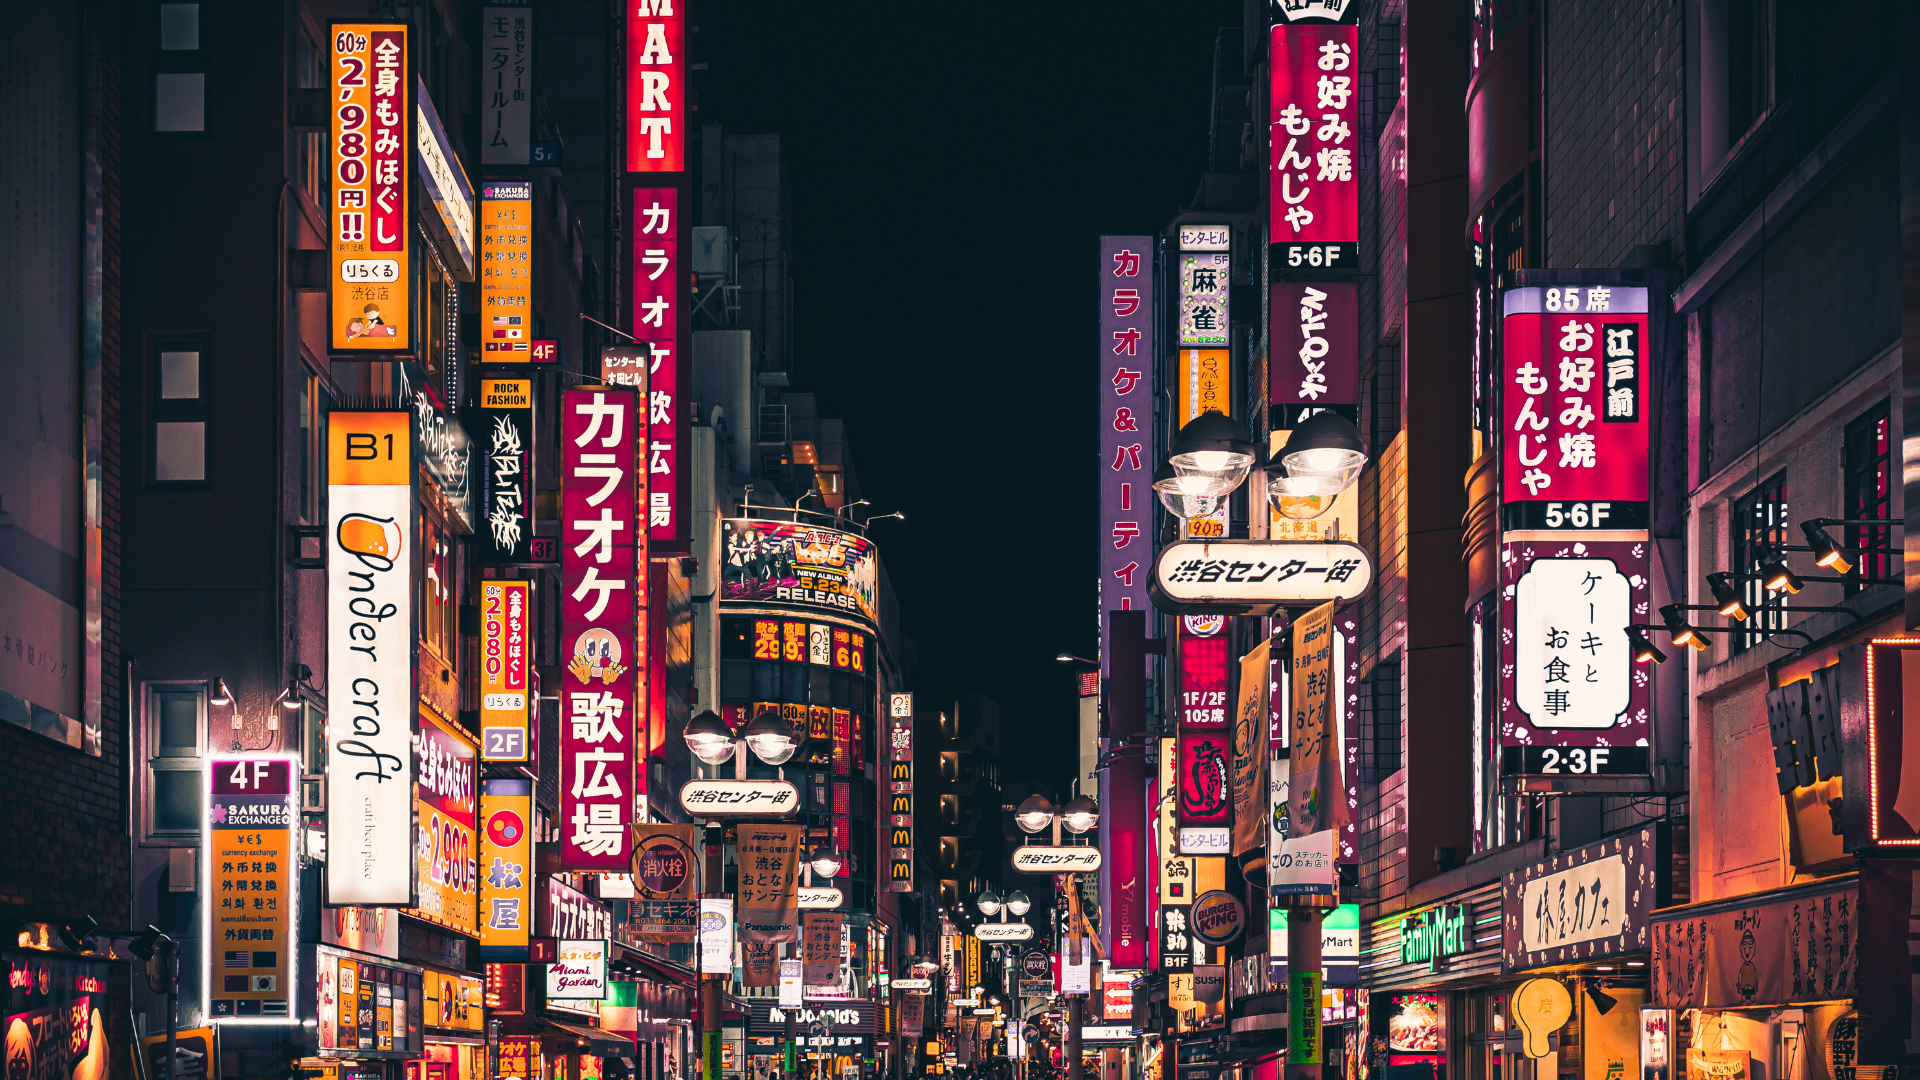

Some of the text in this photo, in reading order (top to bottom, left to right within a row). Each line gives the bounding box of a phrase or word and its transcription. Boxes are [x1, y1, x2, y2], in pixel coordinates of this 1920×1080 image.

[336, 32, 367, 53] 60分
[513, 18, 526, 101] 渋谷センター街
[490, 17, 509, 147] モニタールーム
[1317, 40, 1352, 182] お好み焼
[375, 38, 401, 244] 全身もみほぐし
[337, 58, 367, 242] 2,980円!!
[535, 147, 554, 161] 5F
[1279, 104, 1313, 232] もんじゃ
[1181, 231, 1228, 244] センタービル
[1215, 256, 1228, 265] 5F
[345, 263, 394, 279] りらくる
[352, 287, 390, 301] 渋谷店
[1192, 268, 1217, 329] 麻雀
[533, 345, 554, 359] 4F
[605, 356, 644, 368] センター街
[1607, 329, 1634, 417] 江戸前
[494, 383, 519, 393] ROCK
[1558, 319, 1596, 468] お好み焼
[487, 395, 526, 405] FASHION
[1297, 408, 1325, 423] 4
[1514, 362, 1551, 496] もんじゃ
[346, 433, 394, 460] B1
[572, 393, 626, 622] カラオケ
[1279, 521, 1318, 533] 北海道
[535, 542, 553, 558] 3F
[797, 569, 843, 583] NEW ALBUM
[1168, 559, 1361, 584] 渋谷センター街
[486, 586, 501, 597] 60分
[801, 577, 840, 594] 5.23
[777, 586, 857, 610] RELEASE
[1190, 615, 1219, 627] KING
[1580, 571, 1603, 683] ケーキと
[485, 596, 502, 685] 2,980円
[509, 590, 522, 686] 全身もみほぐし
[1543, 626, 1571, 717] お食事
[488, 697, 521, 707] りらくる
[1183, 691, 1226, 706] 1F/2F
[783, 705, 805, 719] 30分
[1185, 708, 1225, 723] 105席
[336, 678, 402, 784] craft
[490, 733, 520, 753] 2F
[230, 762, 270, 789] 4F
[418, 729, 474, 814] 全身もみほぐし
[570, 690, 625, 857] 歌広場
[686, 790, 793, 804] 渋谷センター街
[228, 804, 290, 815] SAKURA
[228, 815, 282, 825] EXCHANGE
[361, 797, 376, 880] craft beer place
[1181, 834, 1229, 847] センタービル
[222, 849, 277, 858] currency exchange
[431, 812, 477, 896] 2,980円
[742, 845, 795, 854] 6月第一日曜日は
[755, 857, 783, 871] 渋谷
[1018, 854, 1098, 865] 渋谷センター街
[1272, 853, 1293, 868] この
[222, 861, 277, 874] 外币兑换
[643, 859, 684, 878] 消火栓
[222, 879, 277, 892] 外幣兌換
[742, 873, 795, 886] おとなり
[486, 857, 523, 931] 松屋
[742, 889, 796, 902] サンデー
[222, 897, 277, 910] 외화 환전
[1199, 901, 1236, 921] BURGER
[745, 922, 791, 932] Panasonic
[1200, 912, 1237, 931] KING
[225, 928, 274, 941] 外貨両替
[814, 932, 831, 941] 渋谷
[978, 928, 1029, 936] 渋谷センター街
[1400, 903, 1465, 972] FamilyMart
[1026, 960, 1046, 969] 消火栓
[1165, 956, 1188, 967] B1F
[549, 963, 592, 976] Miami
[75, 973, 107, 993] Kitchen
[1171, 976, 1195, 991] すし
[1195, 976, 1225, 986] SUSHI
